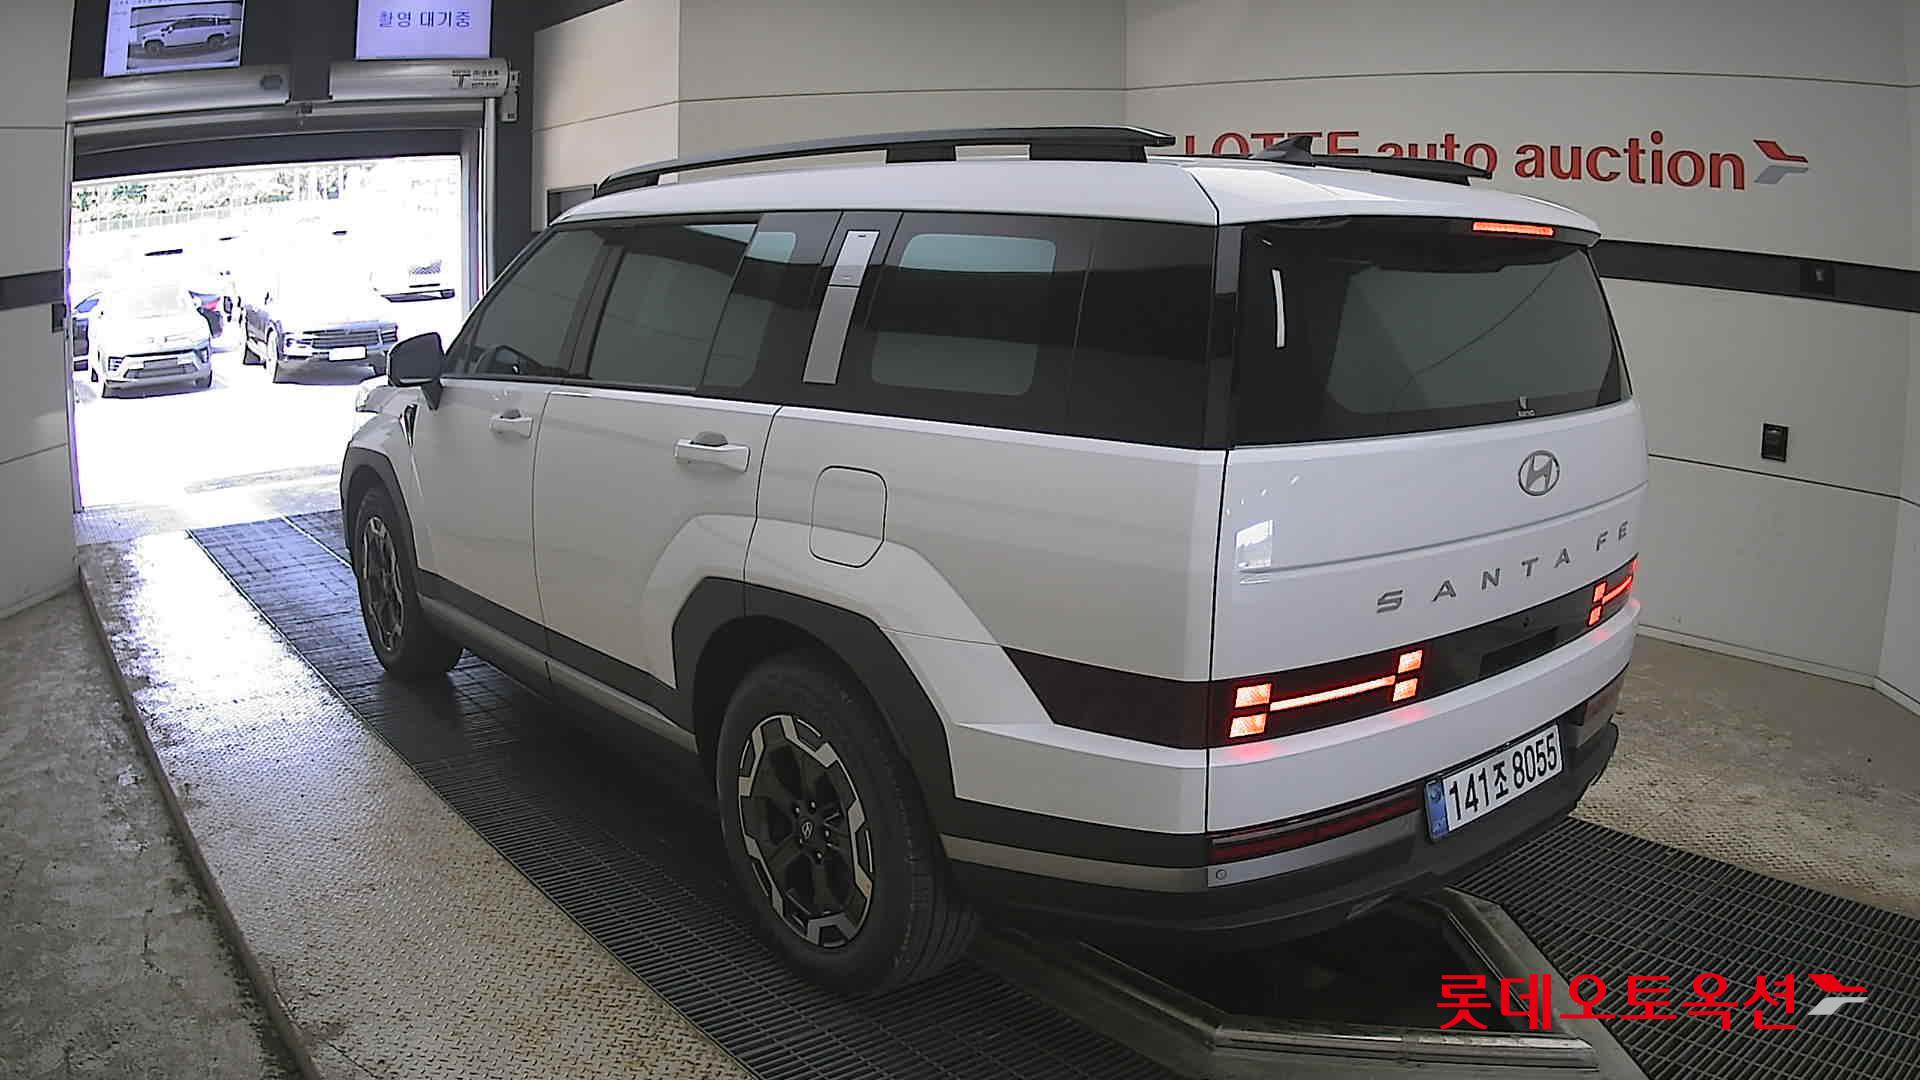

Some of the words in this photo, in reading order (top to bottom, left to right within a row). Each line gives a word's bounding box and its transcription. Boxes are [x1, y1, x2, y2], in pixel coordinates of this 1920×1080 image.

[420, 11, 471, 28] 대기중
[1514, 130, 1745, 190] auction
[1376, 548, 1571, 614] SANTA
[1595, 520, 1630, 552] FE
